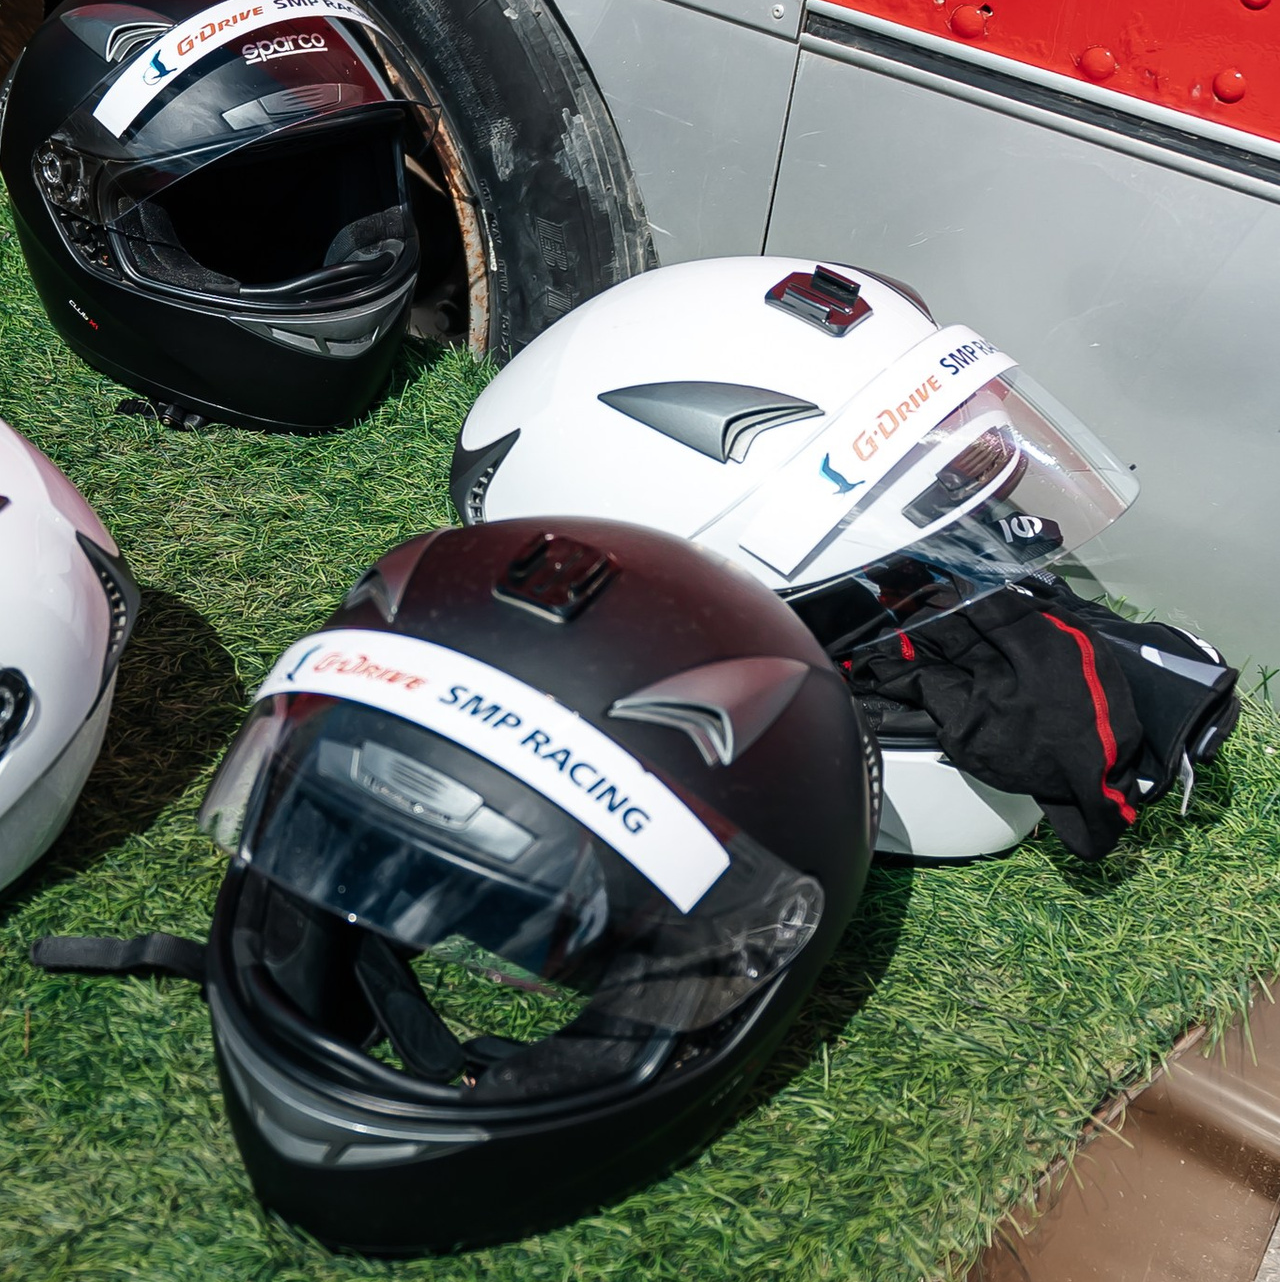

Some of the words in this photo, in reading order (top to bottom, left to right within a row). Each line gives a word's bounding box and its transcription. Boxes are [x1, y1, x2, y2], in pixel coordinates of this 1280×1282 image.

[241, 33, 328, 63] sparco
[939, 344, 979, 376] SMP
[439, 684, 524, 729] SMP
[521, 728, 654, 836] RACING
